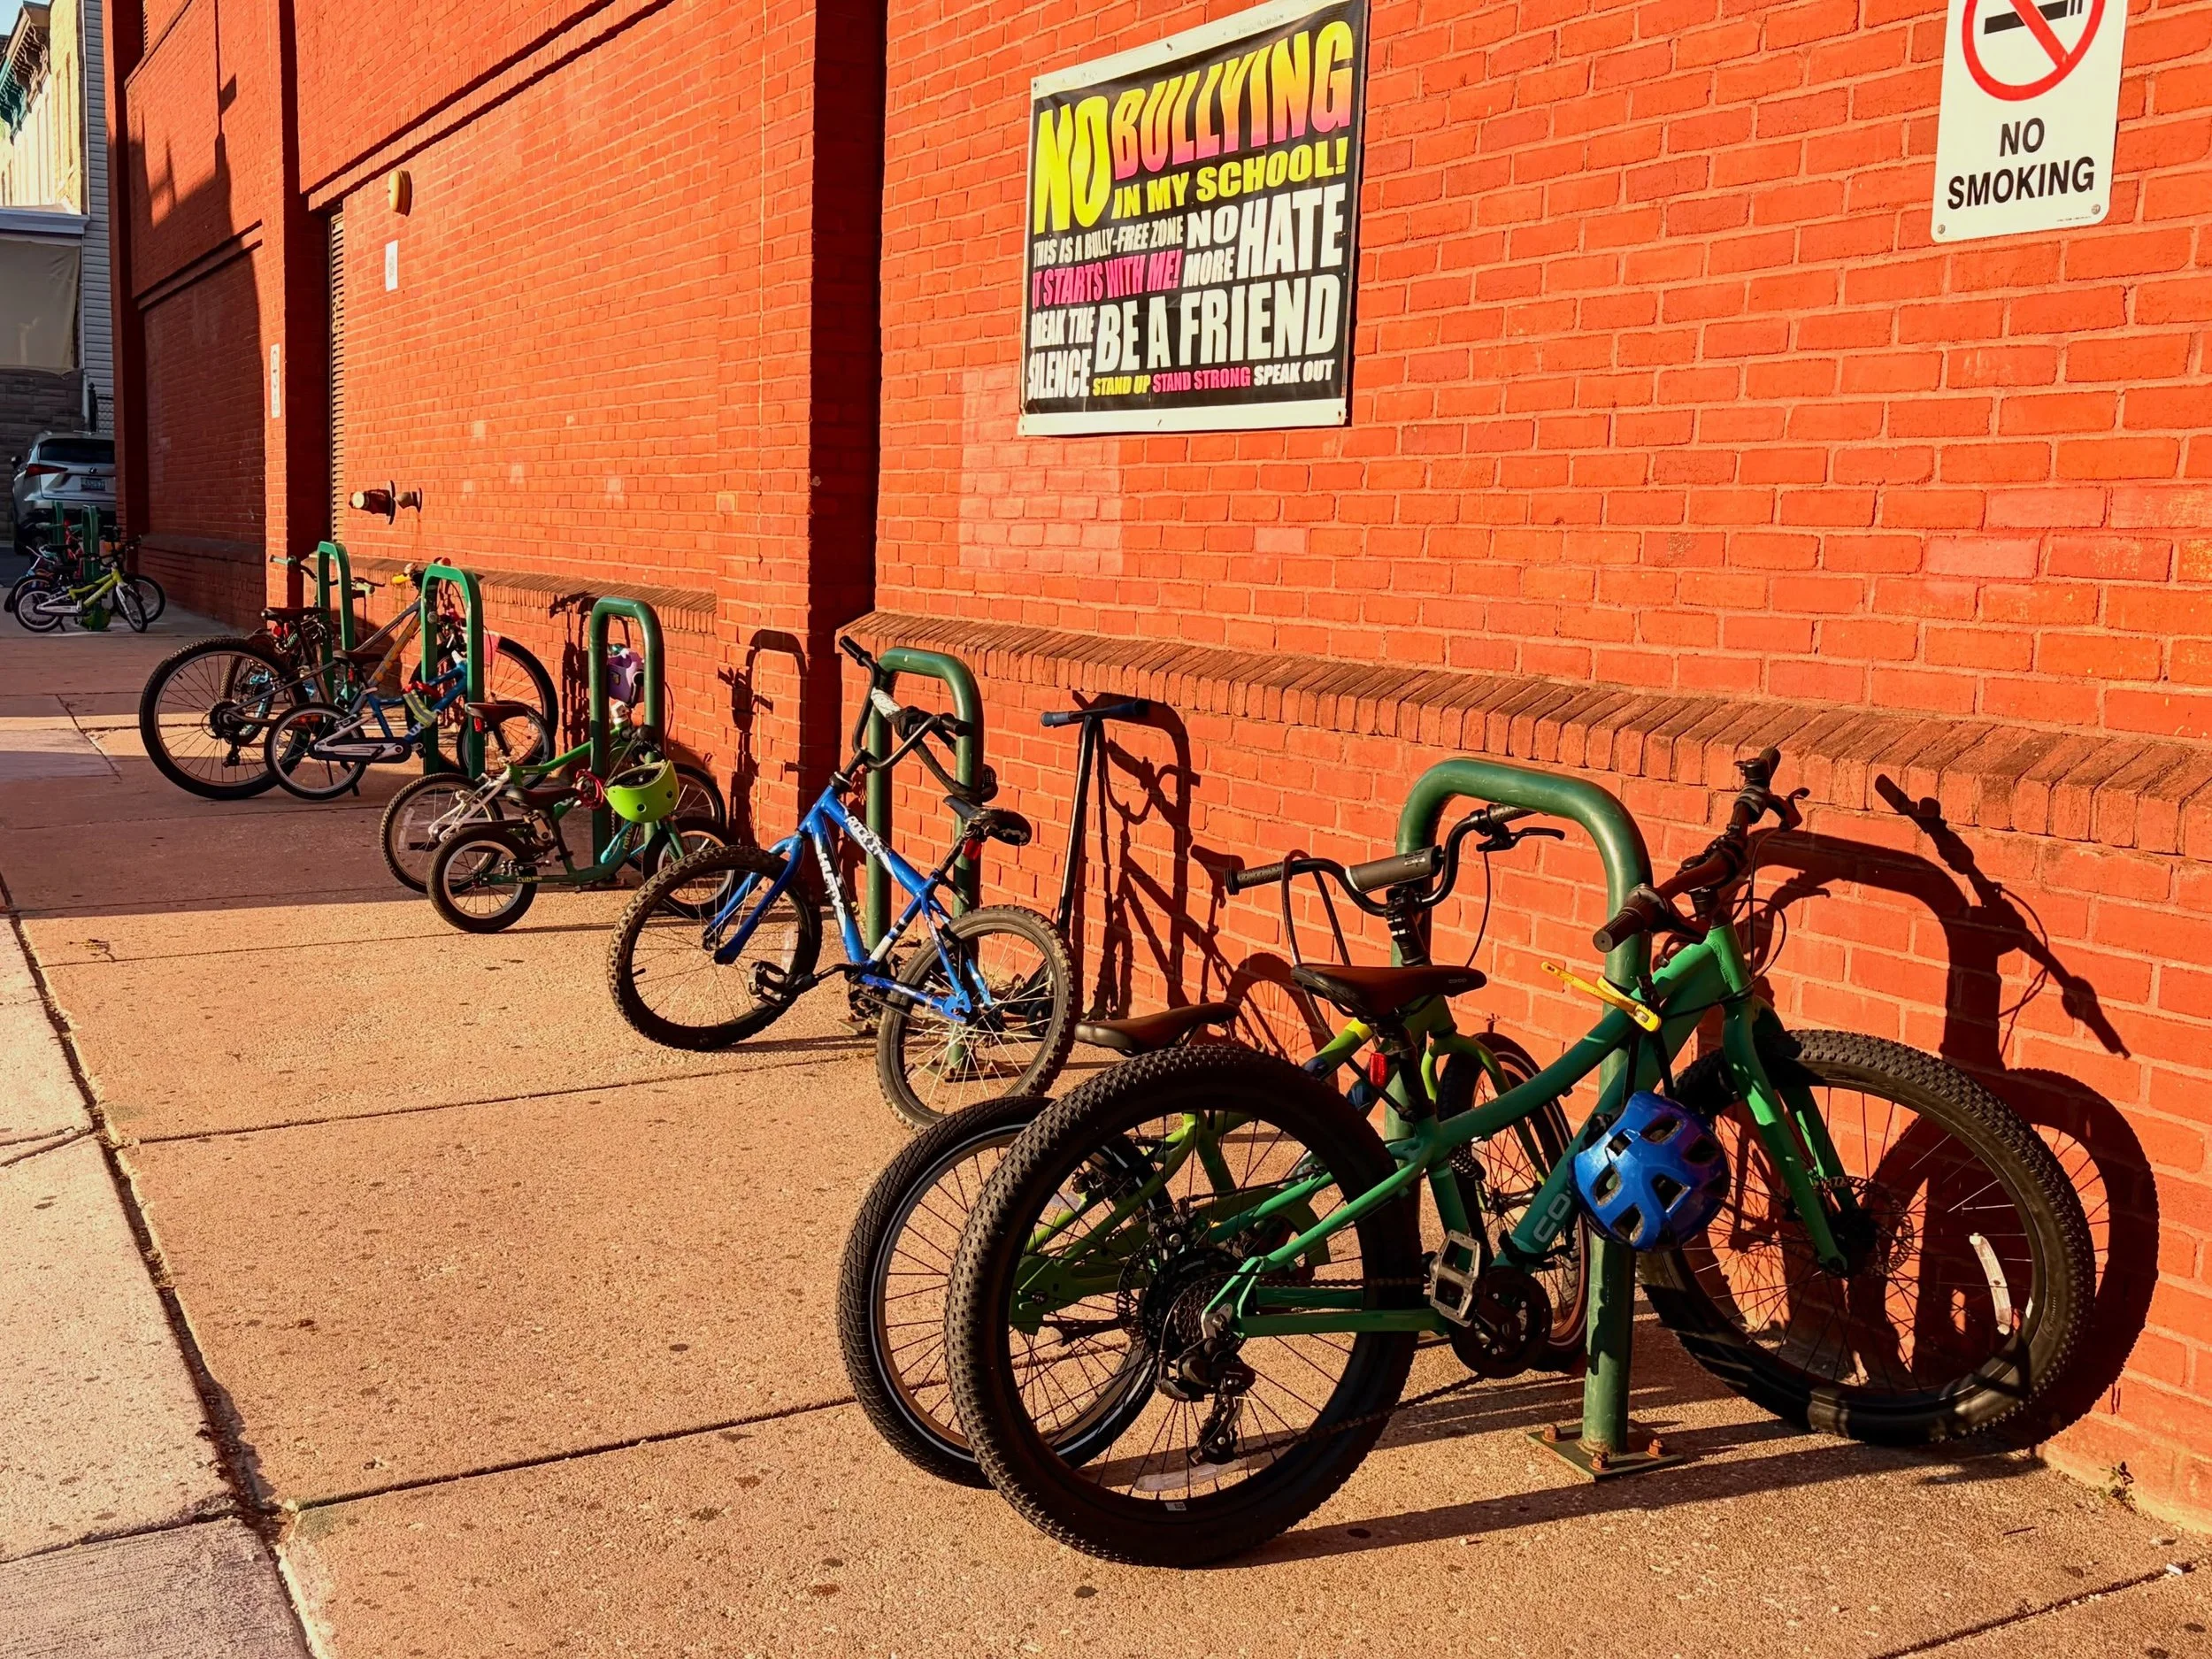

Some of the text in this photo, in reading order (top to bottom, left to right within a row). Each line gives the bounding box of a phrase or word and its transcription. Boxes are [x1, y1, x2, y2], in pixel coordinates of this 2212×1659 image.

[1033, 20, 1354, 235] NO BULLYING
[1999, 117, 2045, 157] NO
[1111, 136, 1349, 219] IN MY SCHOOL!
[1947, 156, 2094, 210] SMOKING
[1033, 215, 1184, 267] THIS IS A BULLY-FREE ZONE
[1187, 204, 1239, 249] NO
[1236, 182, 1346, 280] HATE
[1043, 262, 1104, 306] STARTS
[1105, 255, 1146, 299] WITH
[1147, 250, 1183, 292] ME!
[1183, 247, 1235, 288] MORE
[1068, 306, 1095, 344] THE
[1094, 273, 1340, 373] BE A FRIEND
[1027, 349, 1093, 401] SILENCE
[1093, 359, 1335, 396] STAND UP STAND STRONG SPEAK OUT
[843, 815, 872, 843] ROCK
